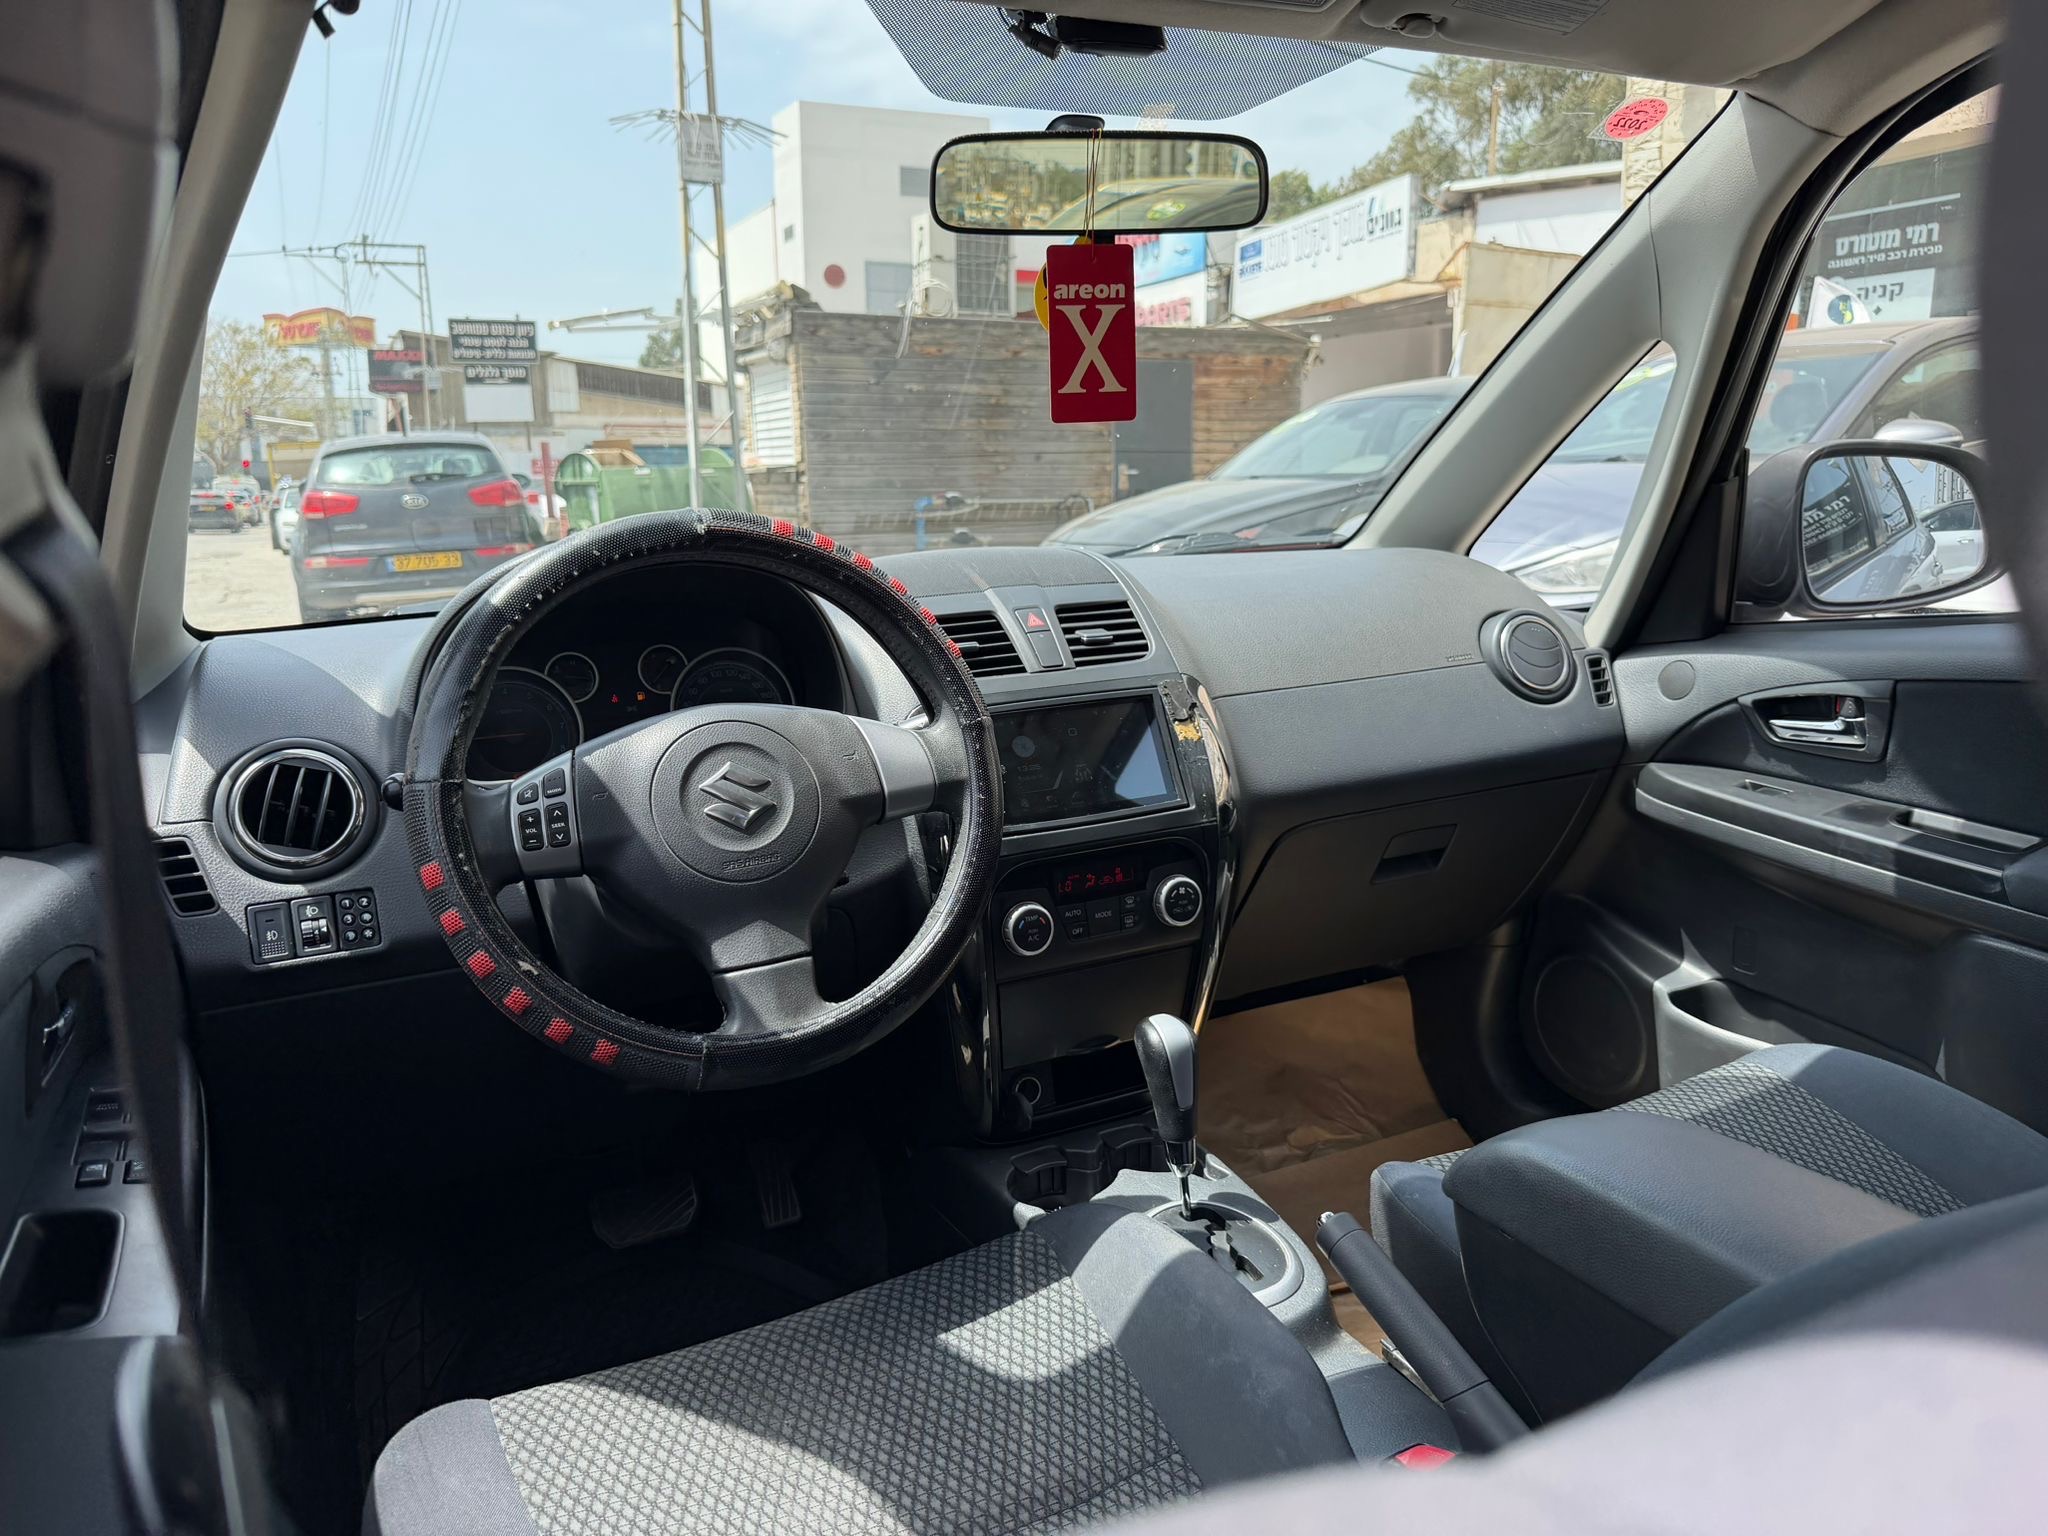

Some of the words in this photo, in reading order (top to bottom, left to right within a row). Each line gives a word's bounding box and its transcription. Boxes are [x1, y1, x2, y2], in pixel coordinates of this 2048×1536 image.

[1905, 222, 1940, 245] רמי
[1835, 228, 1901, 257] מוטורס
[1887, 248, 1908, 261] רכב
[1907, 244, 1943, 258] מכירת
[1827, 256, 1866, 269] ראשונה
[1866, 252, 1887, 264] מיד
[1054, 283, 1126, 300] areon
[1856, 281, 1905, 302] קניה
[1055, 304, 1128, 394] X
[361, 897, 369, 906] 2
[1025, 914, 1039, 922] TEMP
[1065, 909, 1081, 918] AUTO
[1094, 910, 1113, 920] MODE
[1028, 934, 1040, 942] A/C
[1072, 927, 1083, 936] OFF
